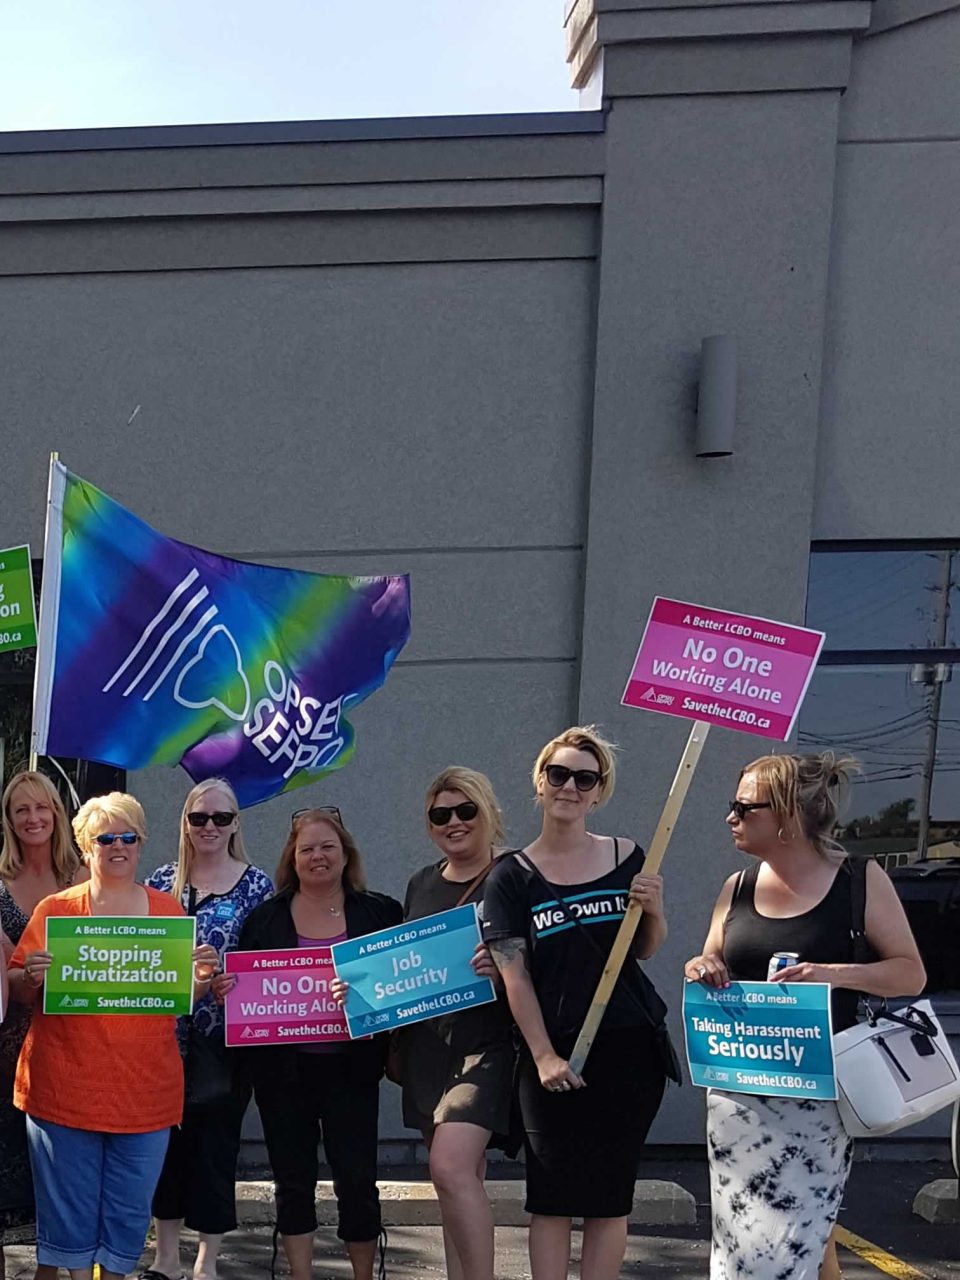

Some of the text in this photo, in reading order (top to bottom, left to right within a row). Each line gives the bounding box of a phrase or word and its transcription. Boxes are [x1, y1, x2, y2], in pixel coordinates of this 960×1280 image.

[683, 615, 786, 646] A Better LCBO means
[682, 638, 772, 677] No One
[652, 660, 782, 704] Working Alone
[682, 697, 770, 728] SavetheLCBO.ca
[534, 909, 564, 929] We
[569, 900, 612, 918] Own
[84, 926, 111, 934] Better
[359, 923, 447, 954] A Better LCBO means
[78, 945, 162, 966] Stopping
[253, 960, 260, 968] A
[261, 959, 288, 968] Better
[290, 958, 313, 966] LCBO
[392, 951, 422, 976] Job
[62, 965, 177, 983] Privatization
[375, 967, 449, 1000] Security
[262, 977, 291, 996] No
[712, 992, 740, 1002] Better
[742, 992, 765, 1003] LCBO
[767, 995, 797, 1004] means
[97, 997, 175, 1008] SavetheLCBO.ca
[240, 1002, 307, 1017] Working
[397, 990, 475, 1019] SavetheLCBO.ca
[692, 1017, 821, 1039] Taking Harassment
[708, 1035, 804, 1067] Seriously
[737, 1072, 816, 1089] SavetheLCBO.ca
